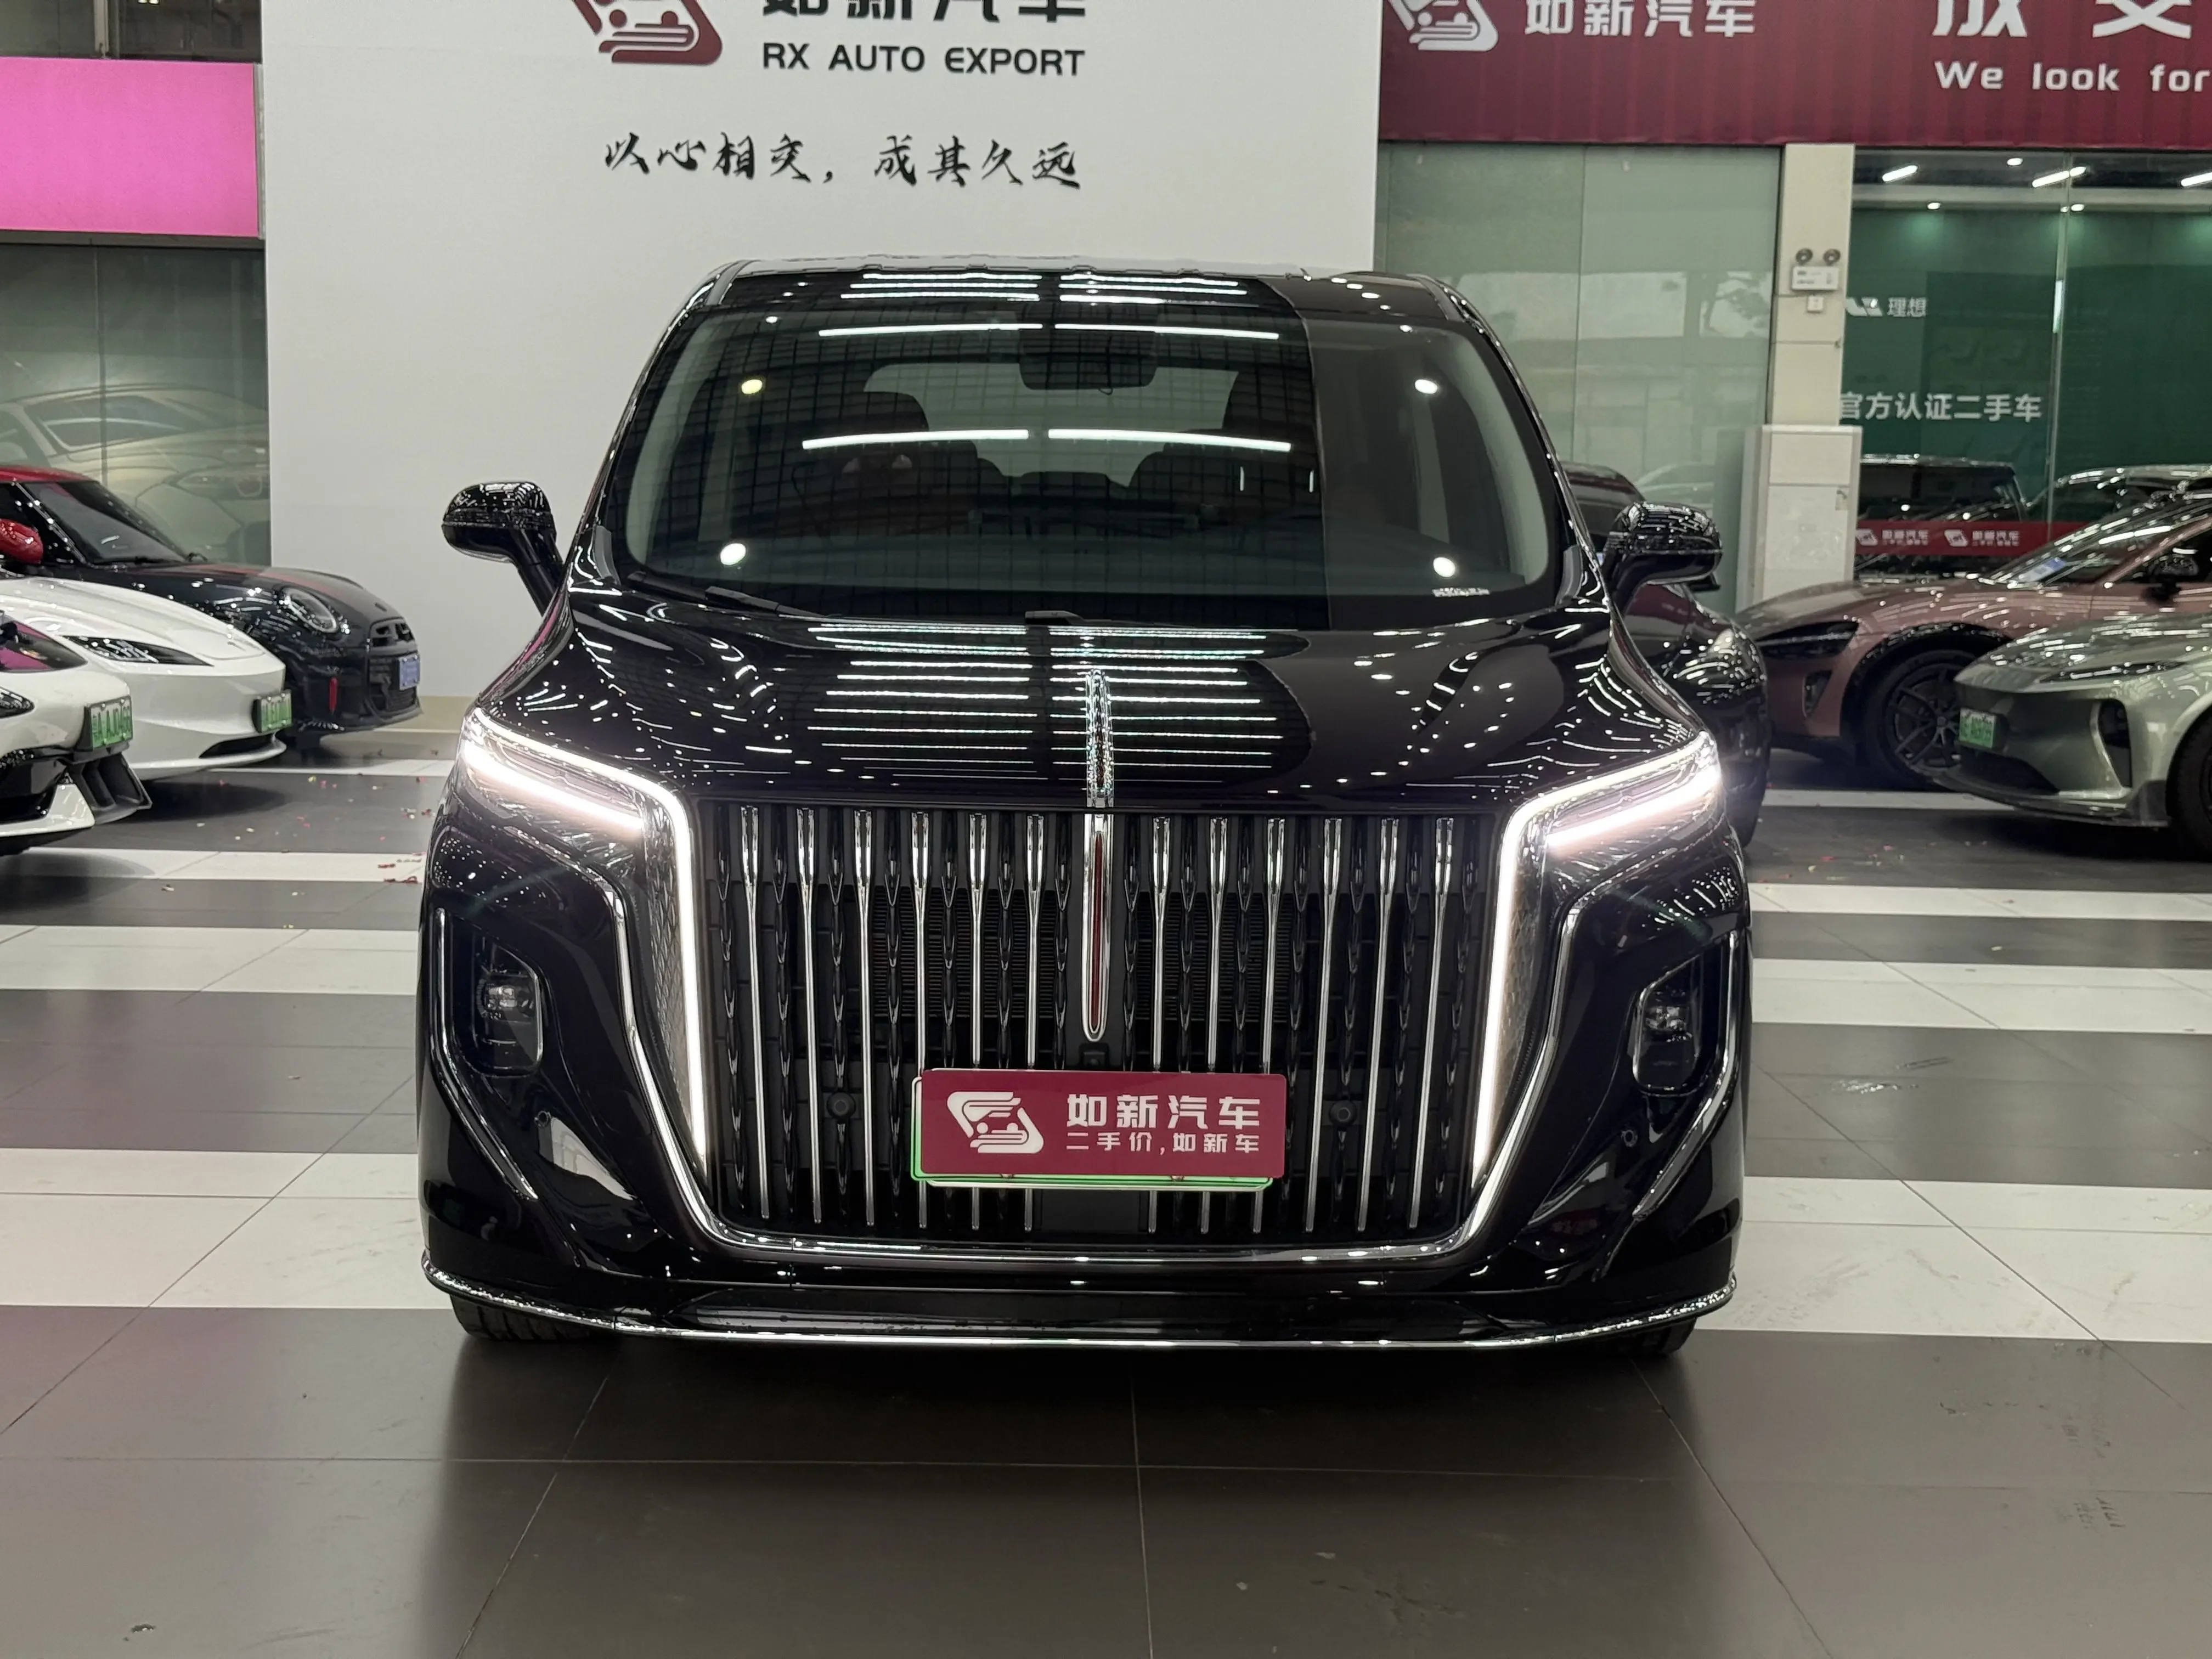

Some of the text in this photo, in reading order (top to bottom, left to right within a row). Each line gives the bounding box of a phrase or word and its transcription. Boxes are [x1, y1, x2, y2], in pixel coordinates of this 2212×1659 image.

[1525, 0, 1756, 38] 如新汽车
[763, 42, 1085, 76] RX AUTO EXPORT
[1934, 61, 2211, 92] We look for
[1887, 297, 1927, 318] 理想
[1840, 391, 2042, 423] 官方认证二手车
[1066, 1094, 1260, 1130] 如新汽车
